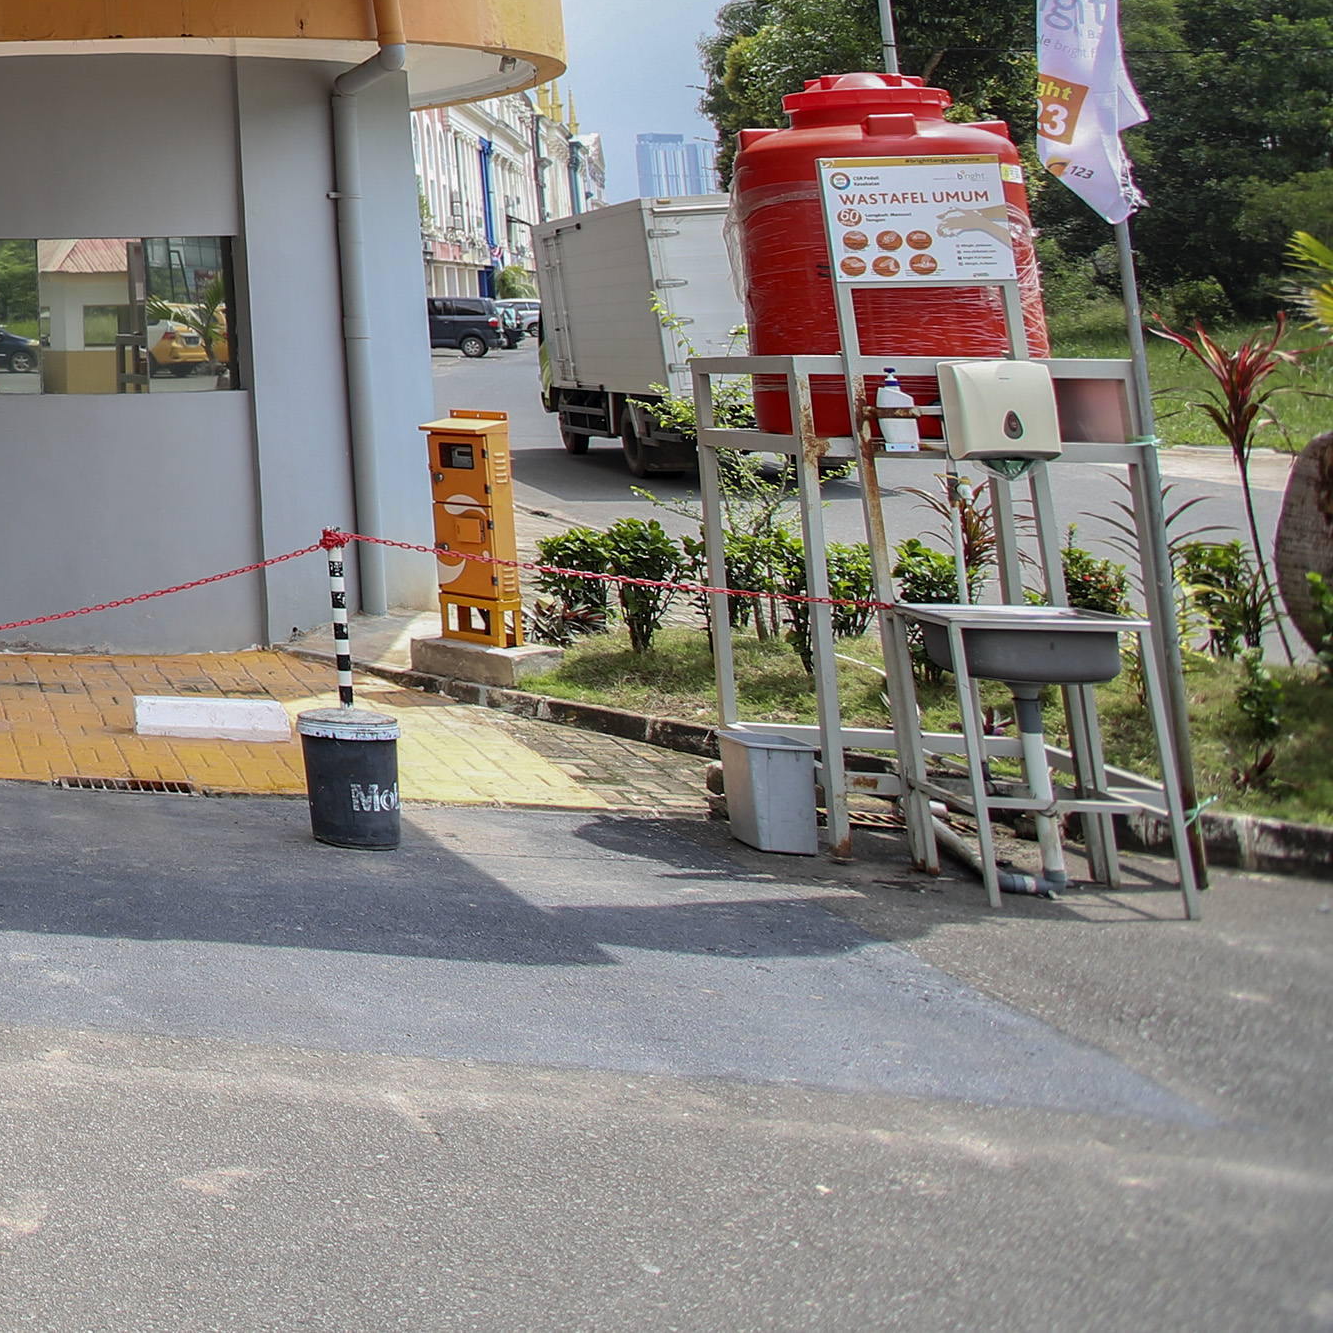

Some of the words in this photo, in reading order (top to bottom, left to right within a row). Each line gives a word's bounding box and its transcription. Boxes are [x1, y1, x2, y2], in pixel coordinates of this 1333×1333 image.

[1069, 165, 1095, 179] 123
[838, 192, 928, 206] WASTAFEL
[933, 190, 989, 204] UMUM
[840, 209, 859, 222] 60
